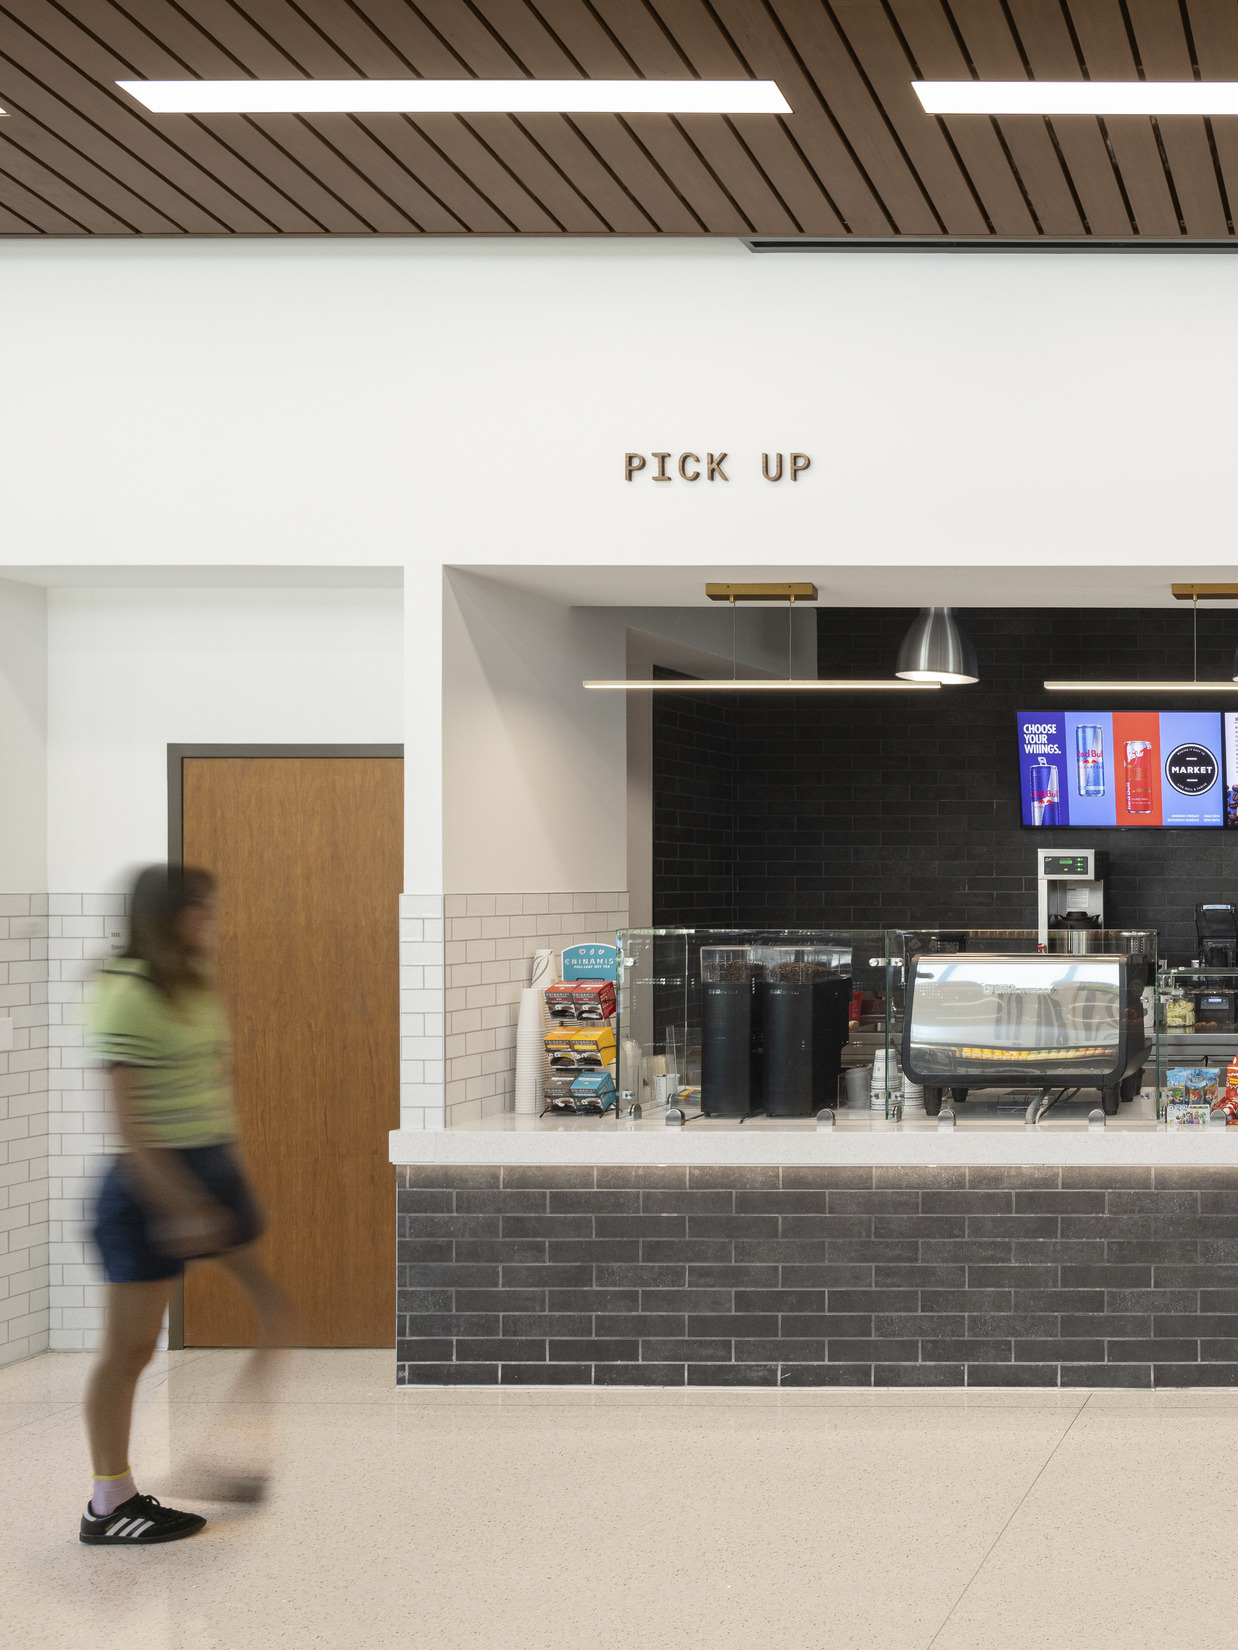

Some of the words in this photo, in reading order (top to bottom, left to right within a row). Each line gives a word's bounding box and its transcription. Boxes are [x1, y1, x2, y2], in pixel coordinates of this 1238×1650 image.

[624, 451, 730, 482] PICK
[761, 452, 811, 482] UP
[1023, 724, 1056, 734] CHOOSE
[1024, 734, 1048, 744] YOUR
[1024, 744, 1062, 754] WIIINGS.
